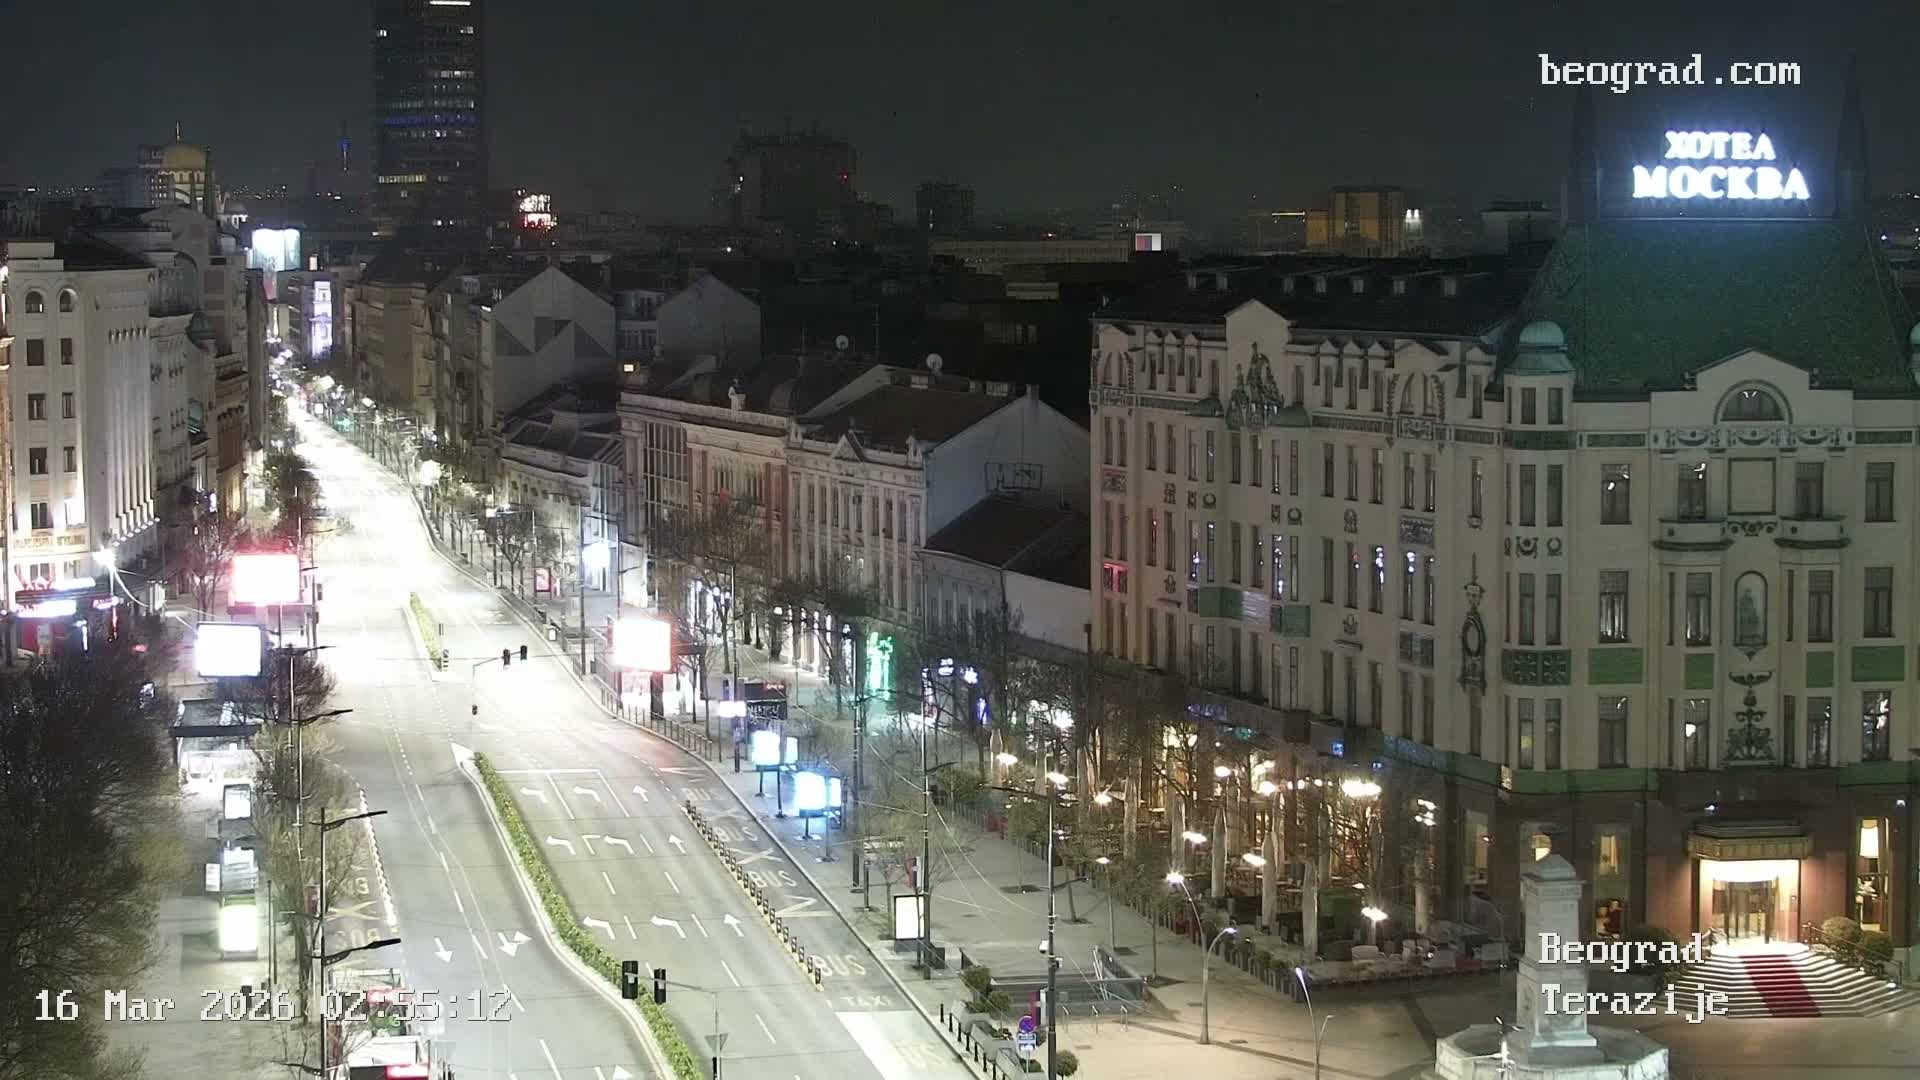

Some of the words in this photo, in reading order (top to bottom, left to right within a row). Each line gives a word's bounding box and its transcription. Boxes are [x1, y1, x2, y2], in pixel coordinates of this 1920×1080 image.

[1664, 131, 1776, 160] ХОТЕЛ
[1631, 165, 1811, 200] МОСКВА
[713, 826, 758, 842] BUS
[746, 870, 797, 888] BUS
[812, 954, 866, 976] BUS
